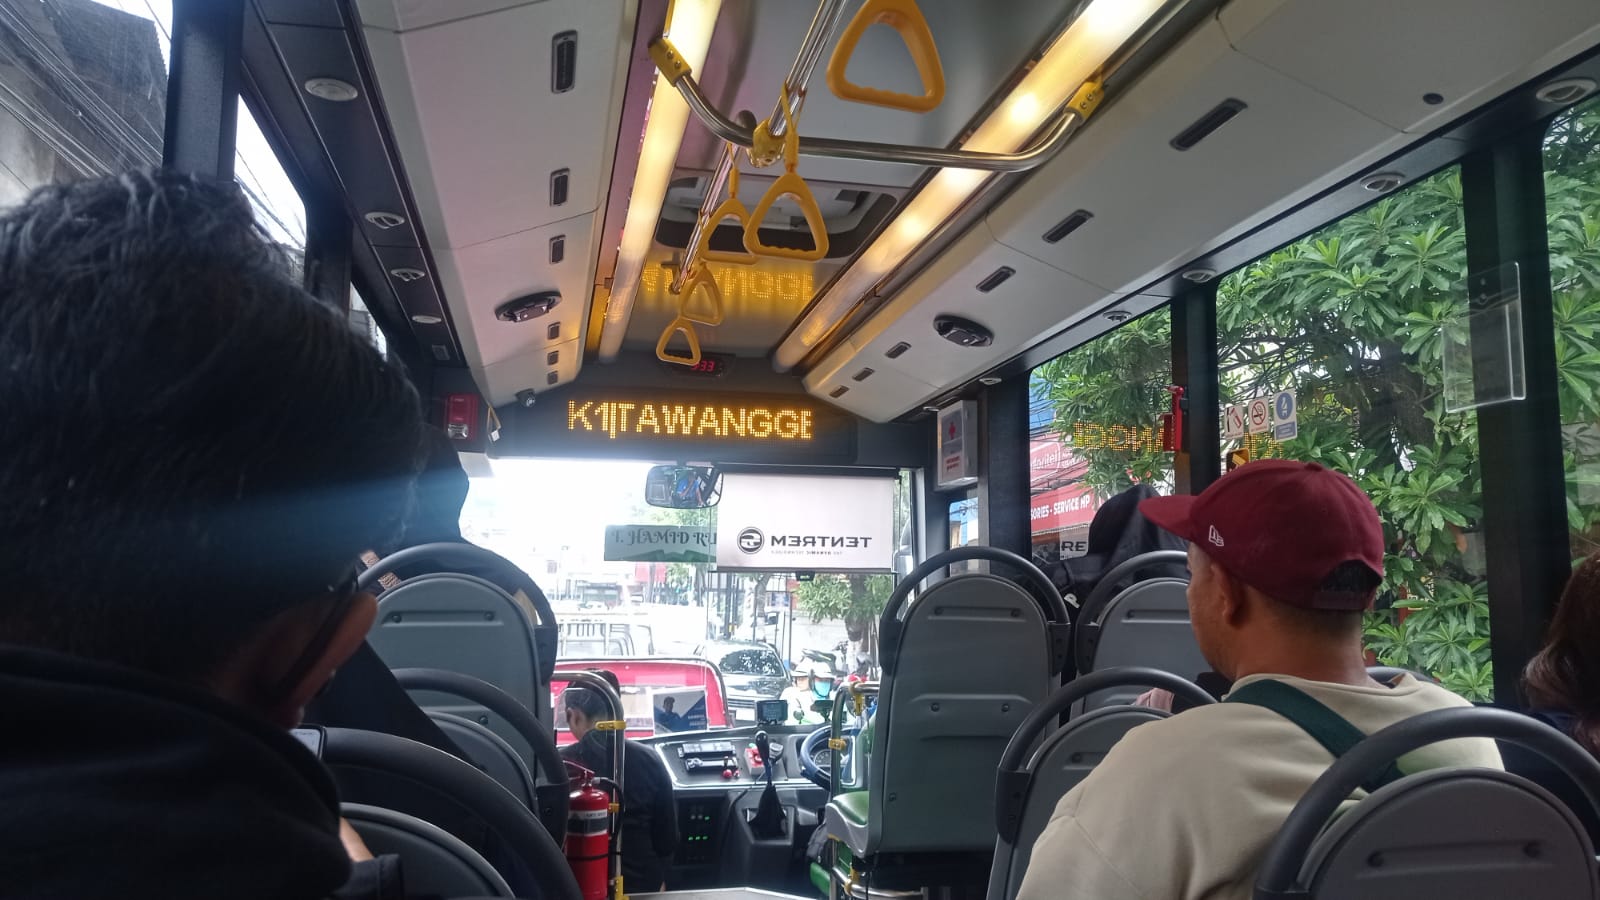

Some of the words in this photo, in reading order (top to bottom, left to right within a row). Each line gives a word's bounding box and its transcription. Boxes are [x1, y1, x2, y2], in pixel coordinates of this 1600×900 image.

[1053, 497, 1079, 515] SERVICE
[1080, 494, 1091, 509] HP
[626, 527, 690, 546] HAMID
